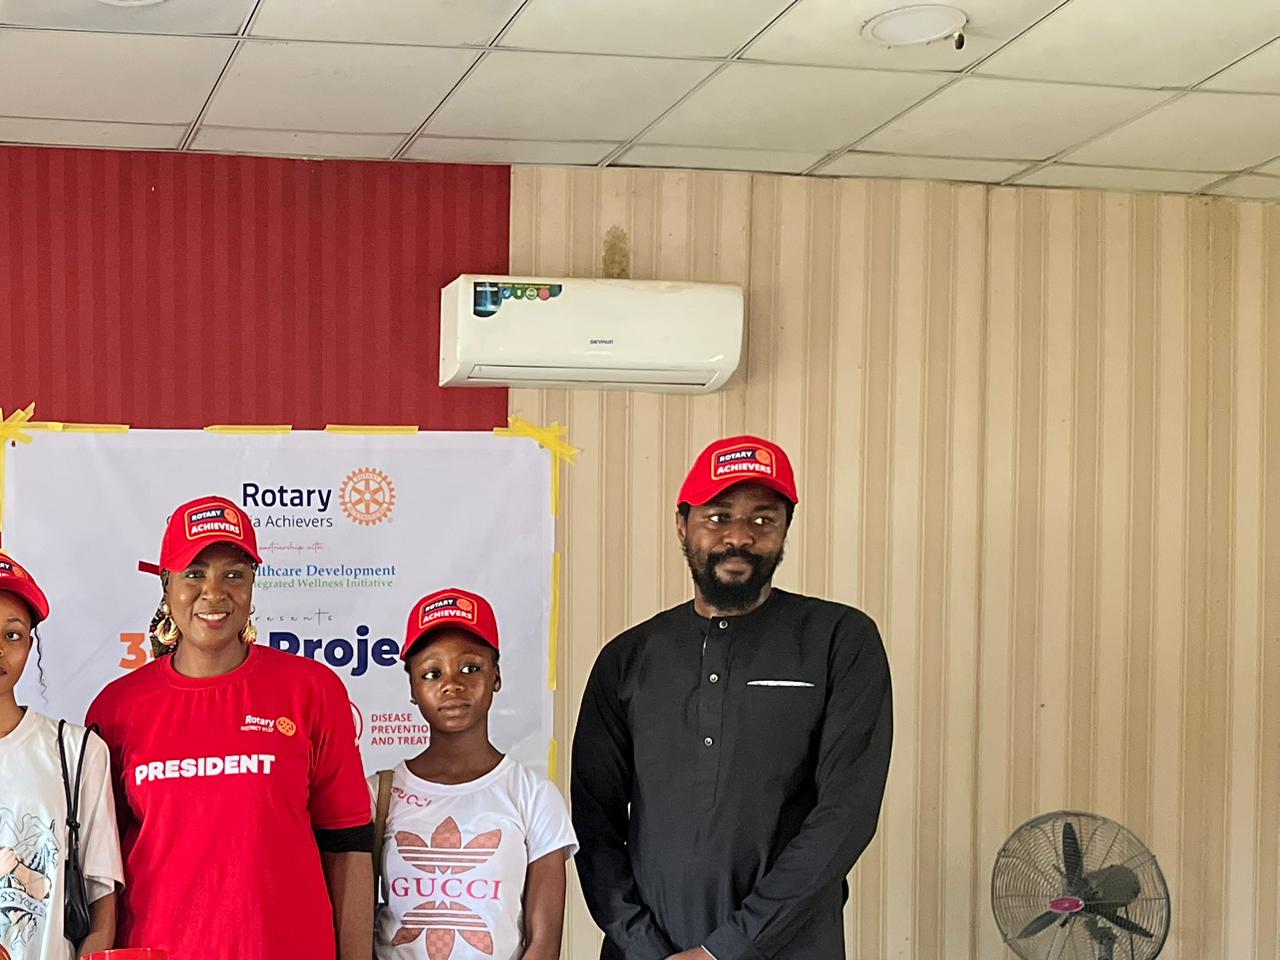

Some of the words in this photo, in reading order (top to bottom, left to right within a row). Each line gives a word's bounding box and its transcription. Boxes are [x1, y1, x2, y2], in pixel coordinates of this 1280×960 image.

[719, 451, 752, 462] ROTARY
[717, 463, 771, 474] ACHIEVERS
[242, 483, 332, 512] Rotary
[192, 510, 221, 521] ROTARY
[191, 522, 240, 534] ACHIEVERS
[265, 516, 333, 528] Achievers
[258, 565, 302, 577] lthcare
[306, 565, 396, 579] Development
[254, 578, 294, 588] tegrated
[297, 578, 344, 588] Wellness
[346, 578, 393, 588] Initiative
[425, 599, 453, 612] ROTARY
[255, 608, 332, 626] resents
[423, 609, 473, 623] ACHIEVERS
[269, 625, 399, 676] Proje
[245, 714, 274, 727] Rotary
[371, 713, 412, 722] DISEASE
[371, 725, 429, 734] PREVENTIO
[371, 736, 394, 746] AND
[397, 736, 430, 745] TREAT
[135, 754, 275, 786] PRESIDENT
[391, 876, 502, 900] GUCCI
